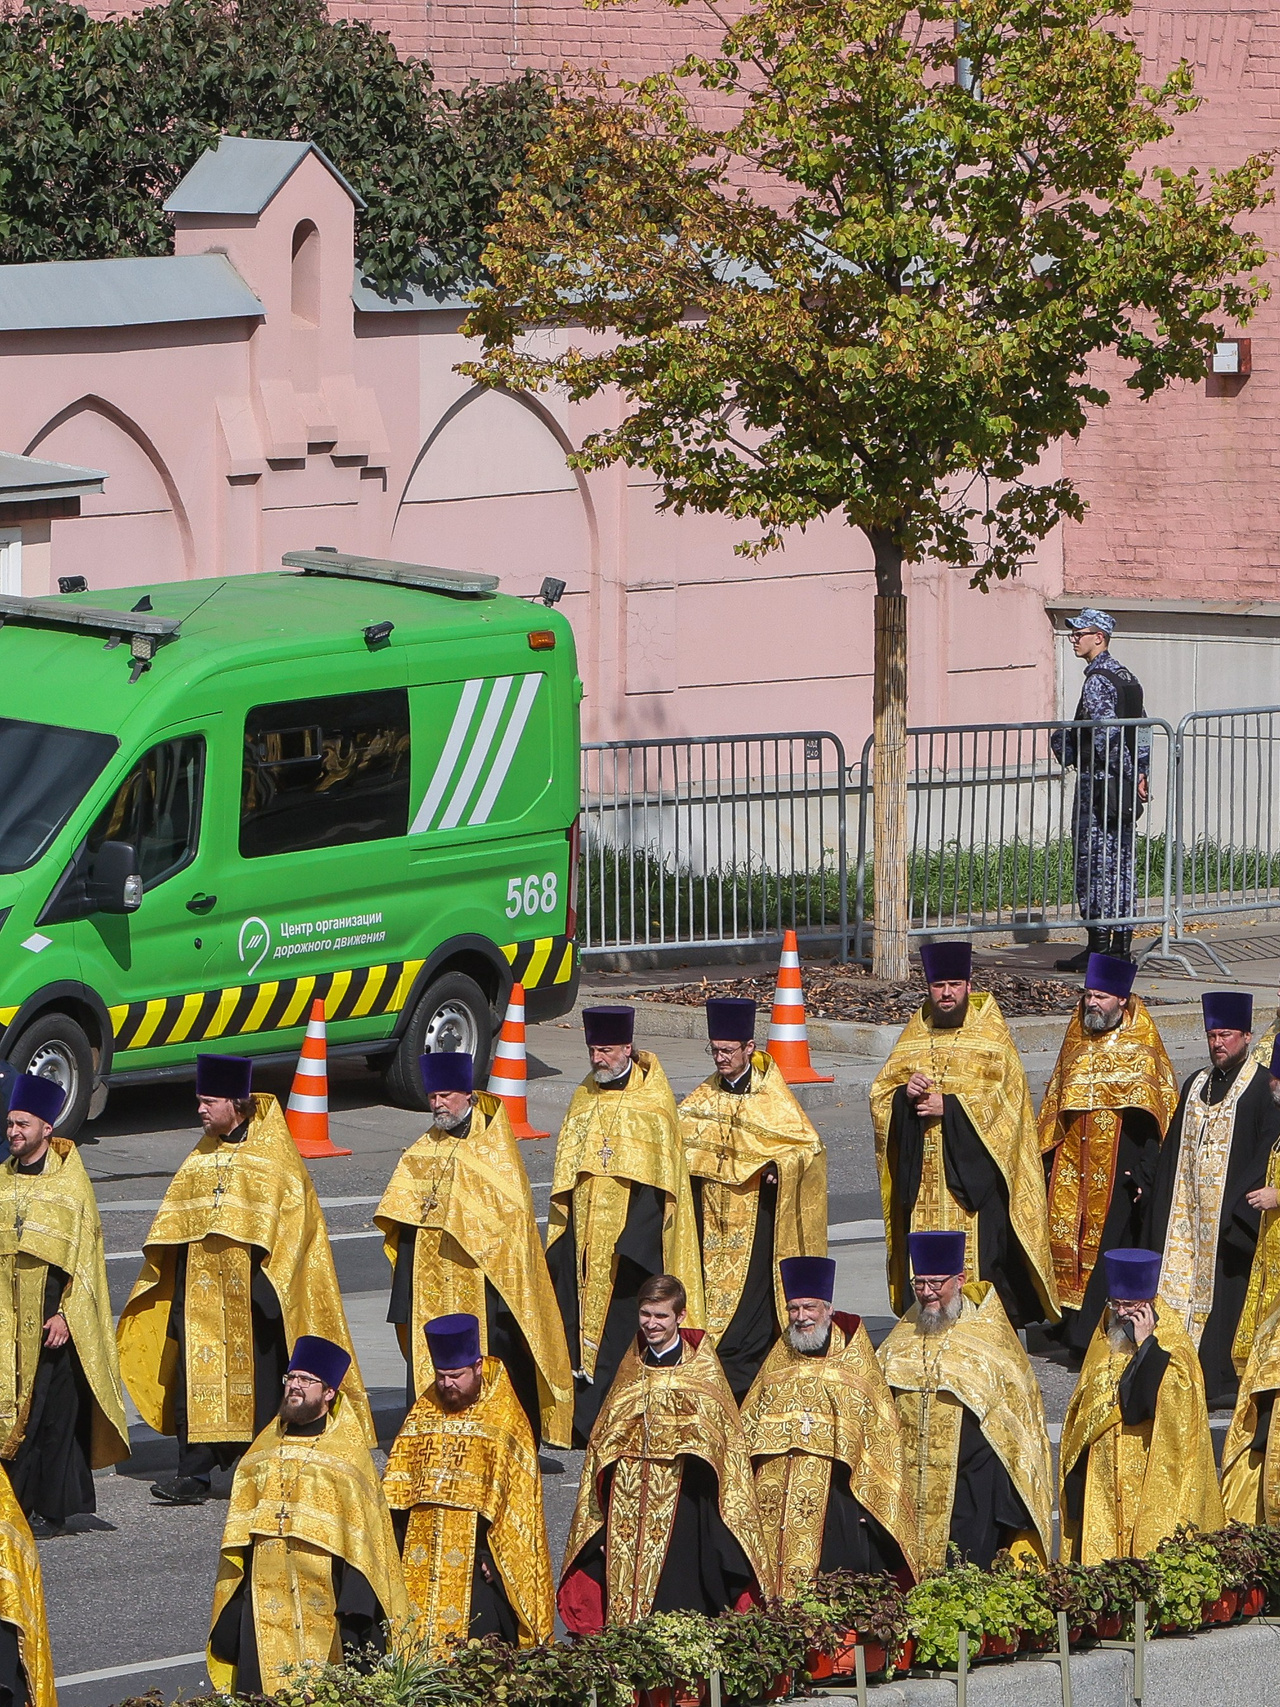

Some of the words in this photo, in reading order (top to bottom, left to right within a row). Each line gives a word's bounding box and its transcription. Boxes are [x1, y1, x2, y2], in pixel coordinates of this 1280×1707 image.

[505, 871, 557, 919] 568
[280, 922, 313, 938] Центр
[315, 912, 382, 934] организации
[273, 938, 332, 959] дорожного
[333, 931, 386, 951] движения
